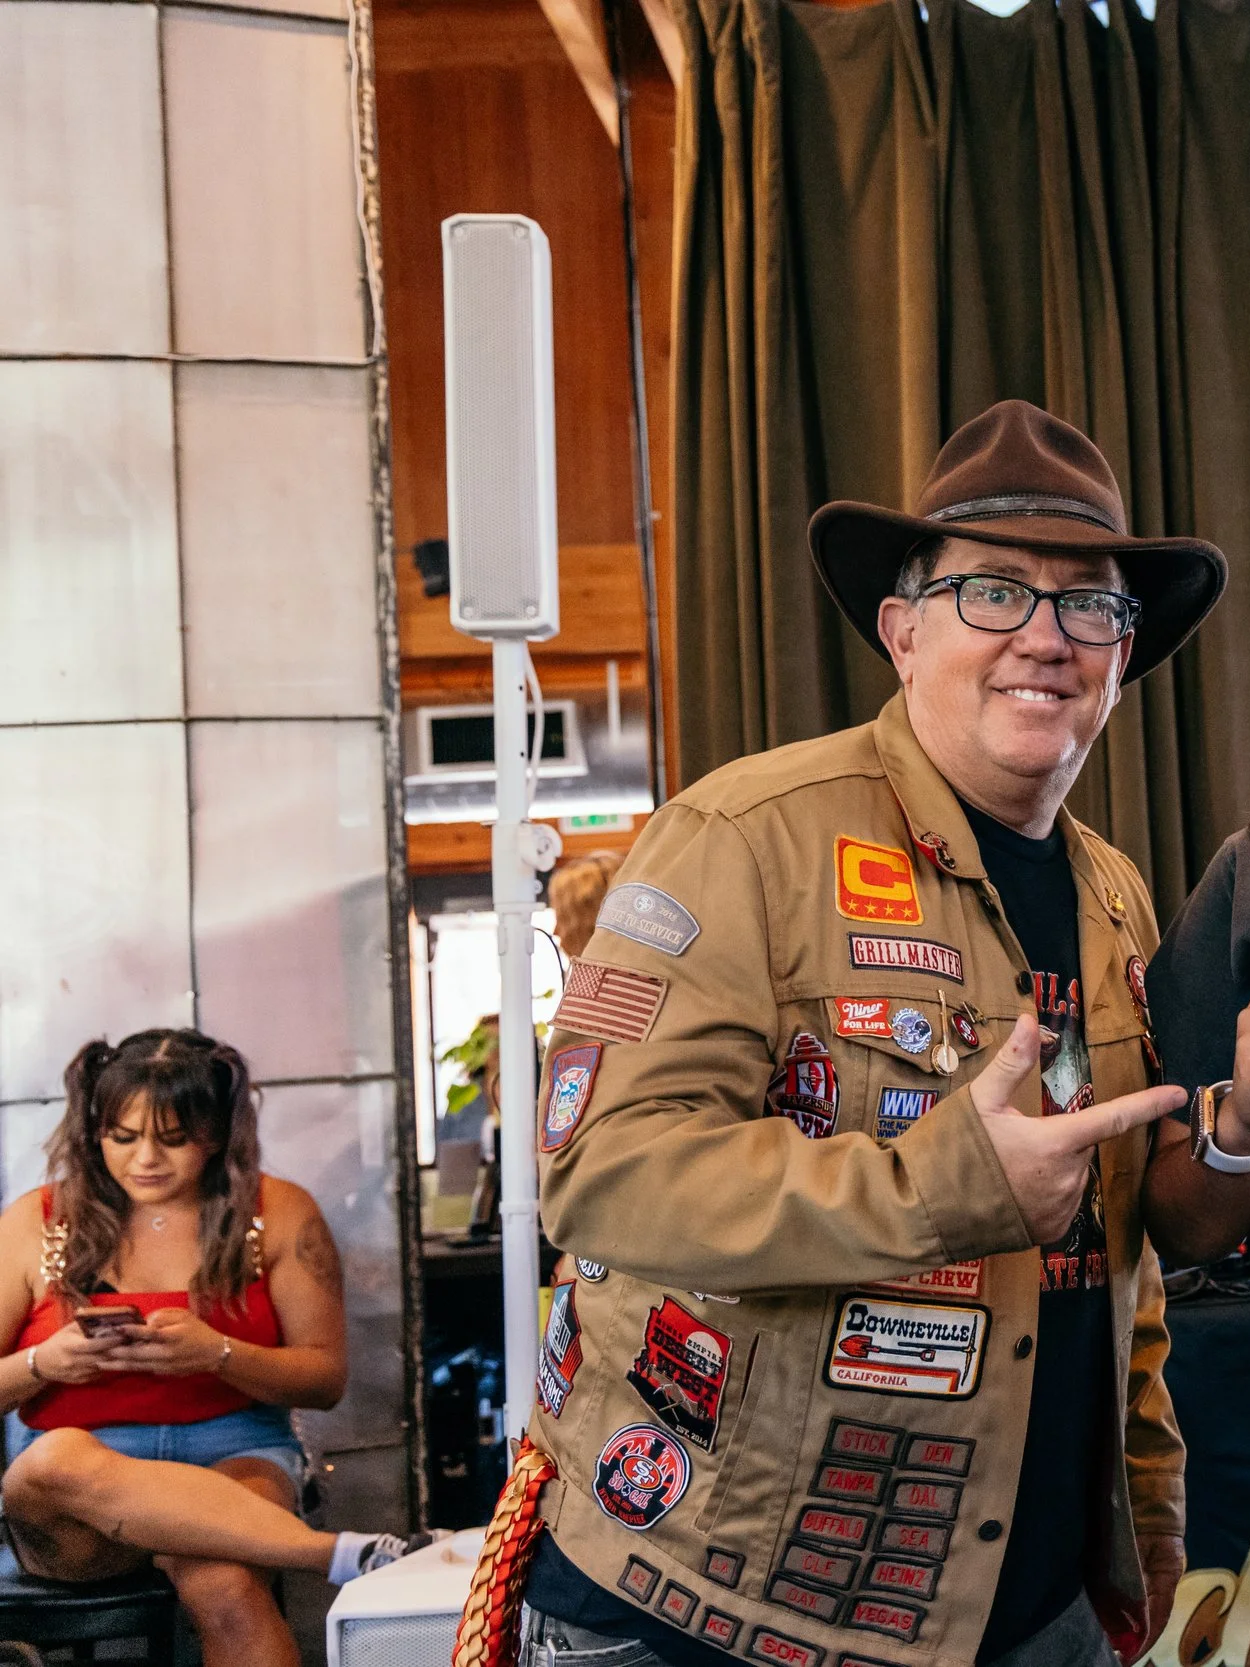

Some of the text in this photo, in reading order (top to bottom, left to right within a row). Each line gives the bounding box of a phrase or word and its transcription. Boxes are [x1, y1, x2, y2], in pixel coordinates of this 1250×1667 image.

[841, 844, 914, 902] C
[638, 919, 684, 946] SERVICE
[855, 940, 962, 977] GRILLMASTER
[843, 1020, 862, 1029] FOR
[846, 1304, 970, 1342] DOWNIEVILLE
[837, 1369, 908, 1386] CALIFORNIA
[842, 1430, 889, 1455] STICK
[922, 1444, 954, 1463] DEN
[827, 1469, 875, 1493] TAMPA
[802, 1510, 864, 1539] BUFFALO
[900, 1528, 930, 1548] SEA
[802, 1554, 837, 1576] CLE
[876, 1564, 927, 1588] HEINZ
[707, 1617, 729, 1636] KC
[855, 1603, 914, 1630] VEGAS
